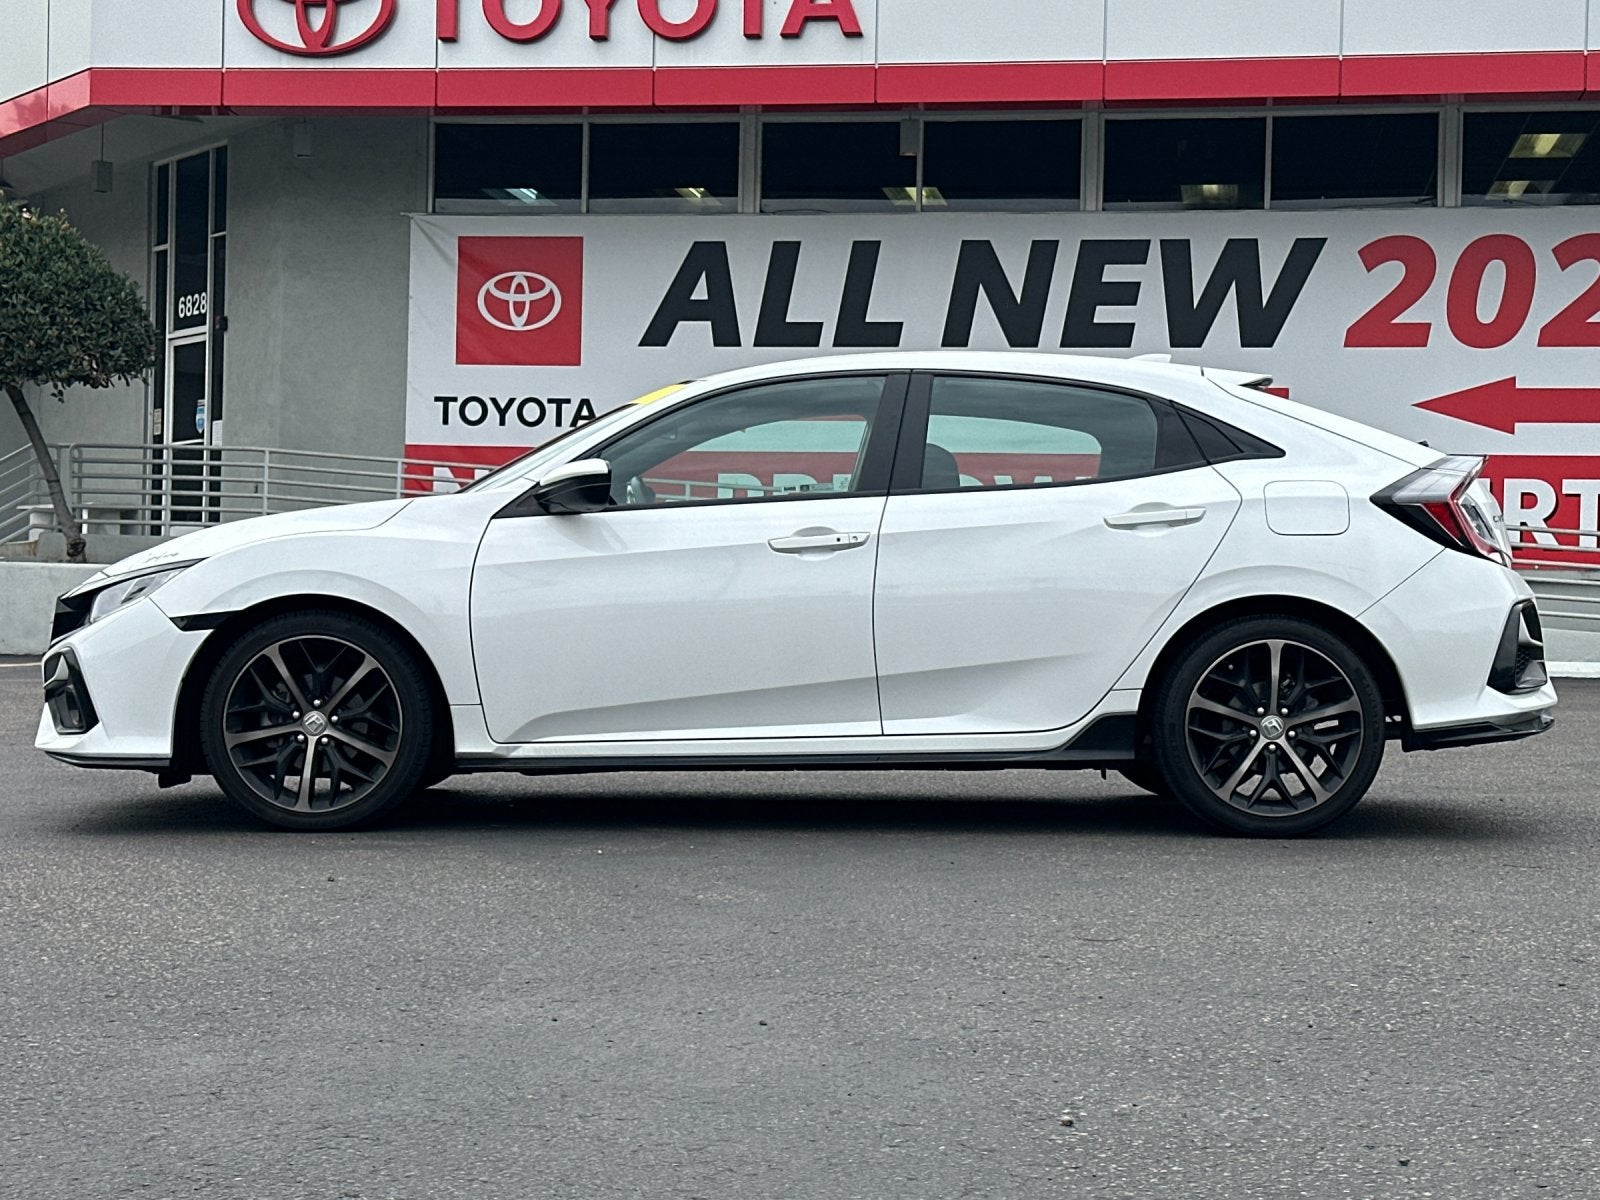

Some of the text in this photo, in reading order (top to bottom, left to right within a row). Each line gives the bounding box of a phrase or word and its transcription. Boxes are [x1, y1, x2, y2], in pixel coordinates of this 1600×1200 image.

[178, 292, 207, 318] 6828
[638, 240, 904, 347] ALL
[941, 238, 1328, 348] NEW
[434, 396, 597, 428] TOYOTA
